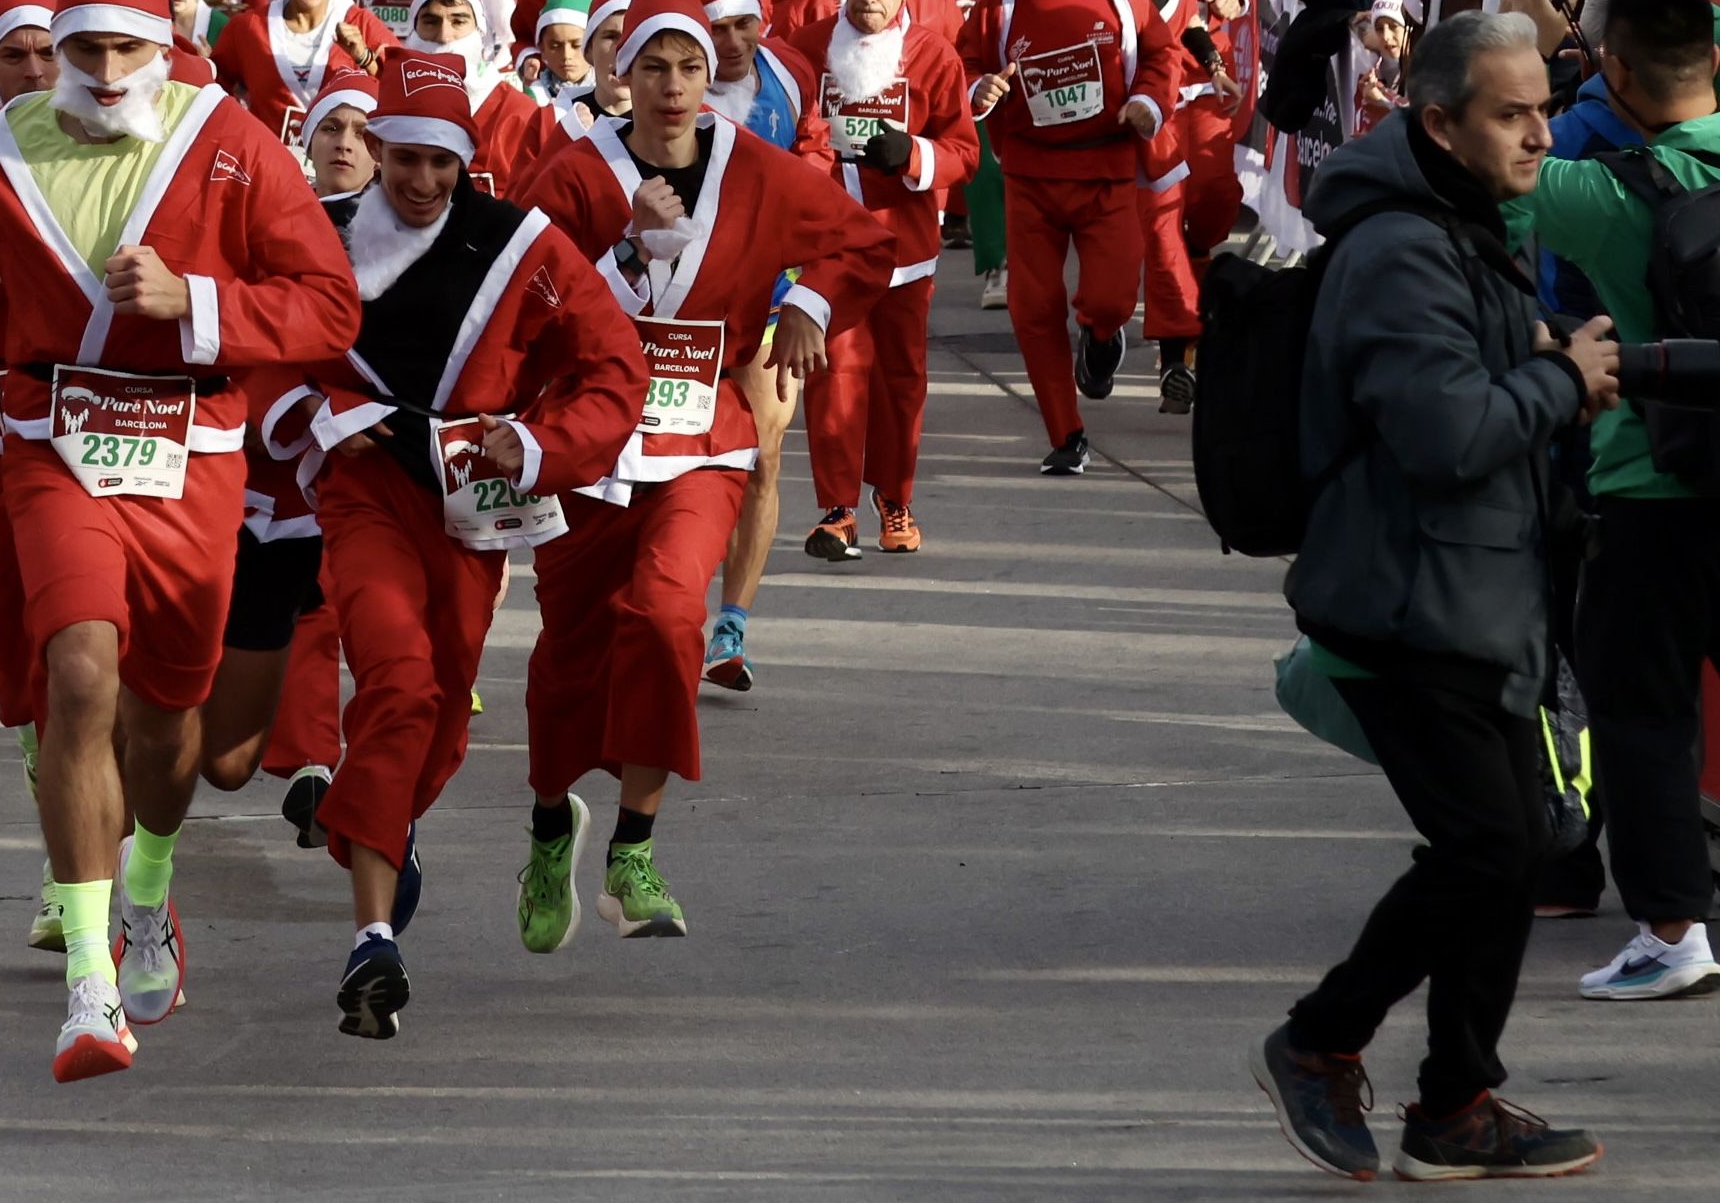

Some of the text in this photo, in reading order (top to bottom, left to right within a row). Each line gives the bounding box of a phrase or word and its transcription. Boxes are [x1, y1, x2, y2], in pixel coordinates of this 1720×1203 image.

[876, 94, 903, 106] Noel
[1044, 83, 1088, 109] 1047
[844, 117, 882, 137] 520
[667, 332, 693, 341] CURSA
[643, 341, 716, 360] Pare Noel
[654, 363, 700, 373] BARCELONA
[124, 386, 154, 395] CURSA
[143, 399, 185, 416] Noel
[115, 419, 168, 430] BARCELONA
[81, 434, 158, 468] 2379
